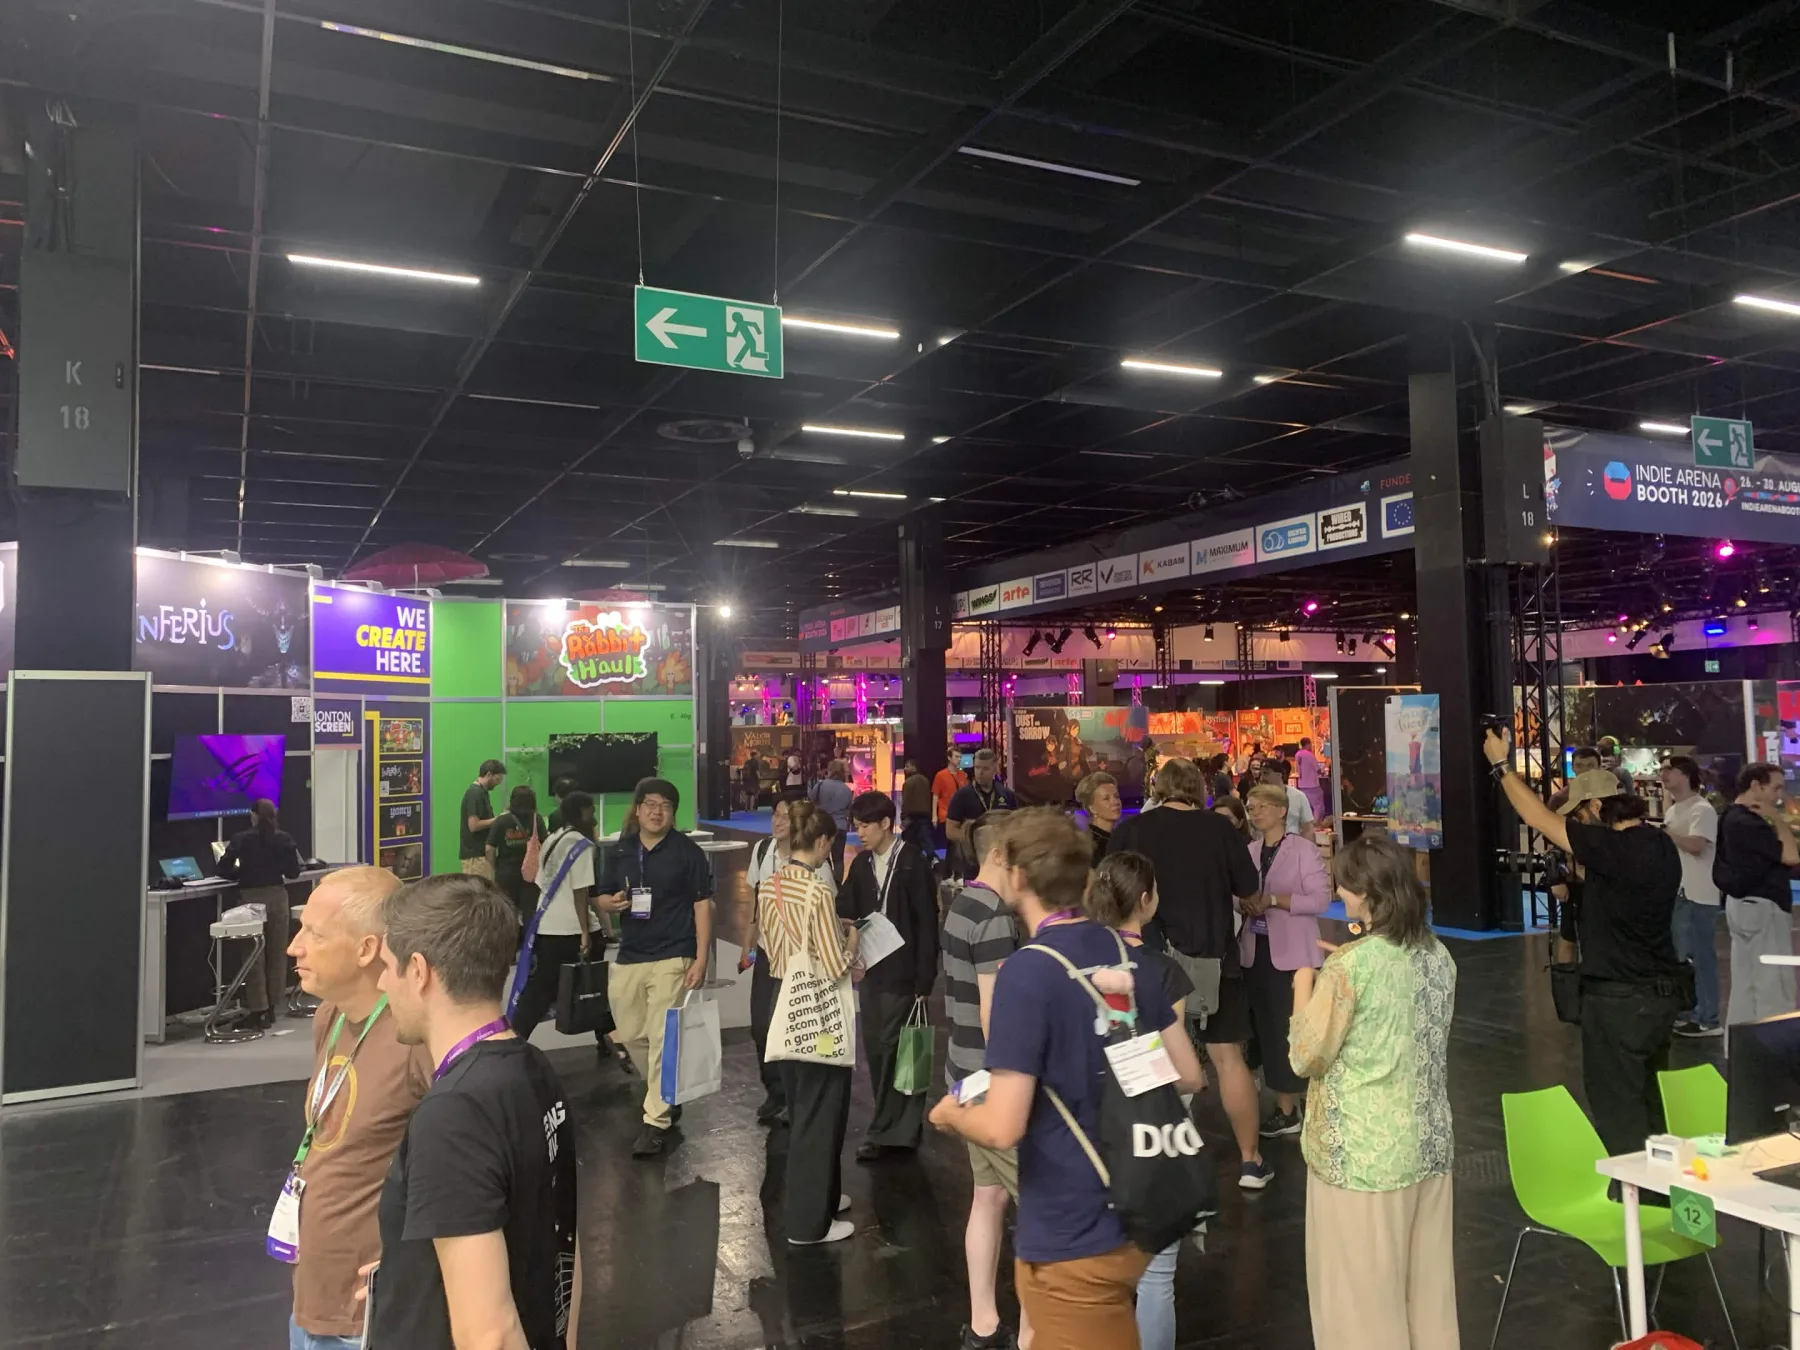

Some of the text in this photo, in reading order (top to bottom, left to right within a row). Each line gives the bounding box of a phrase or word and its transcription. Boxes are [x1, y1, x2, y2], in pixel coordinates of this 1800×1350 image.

[66, 360, 82, 385] K
[60, 405, 90, 430] 18
[1636, 464, 1722, 489] INDIE ARENA
[1523, 483, 1530, 499] L
[1637, 484, 1723, 508] BOOTH 2026
[1522, 511, 1534, 526] 18
[1209, 541, 1249, 557] MAXIMUM
[1157, 556, 1185, 568] KABAM
[1003, 586, 1030, 602] arte
[136, 597, 235, 650] NFERIUS
[396, 606, 426, 629] WE
[356, 625, 427, 651] CREATE
[567, 627, 647, 660] Rabbit
[578, 654, 633, 680] Haul
[314, 721, 351, 733] SCREEN
[1015, 714, 1035, 727] DUST
[1019, 726, 1050, 740] SORROW
[1684, 1206, 1701, 1226] 12
